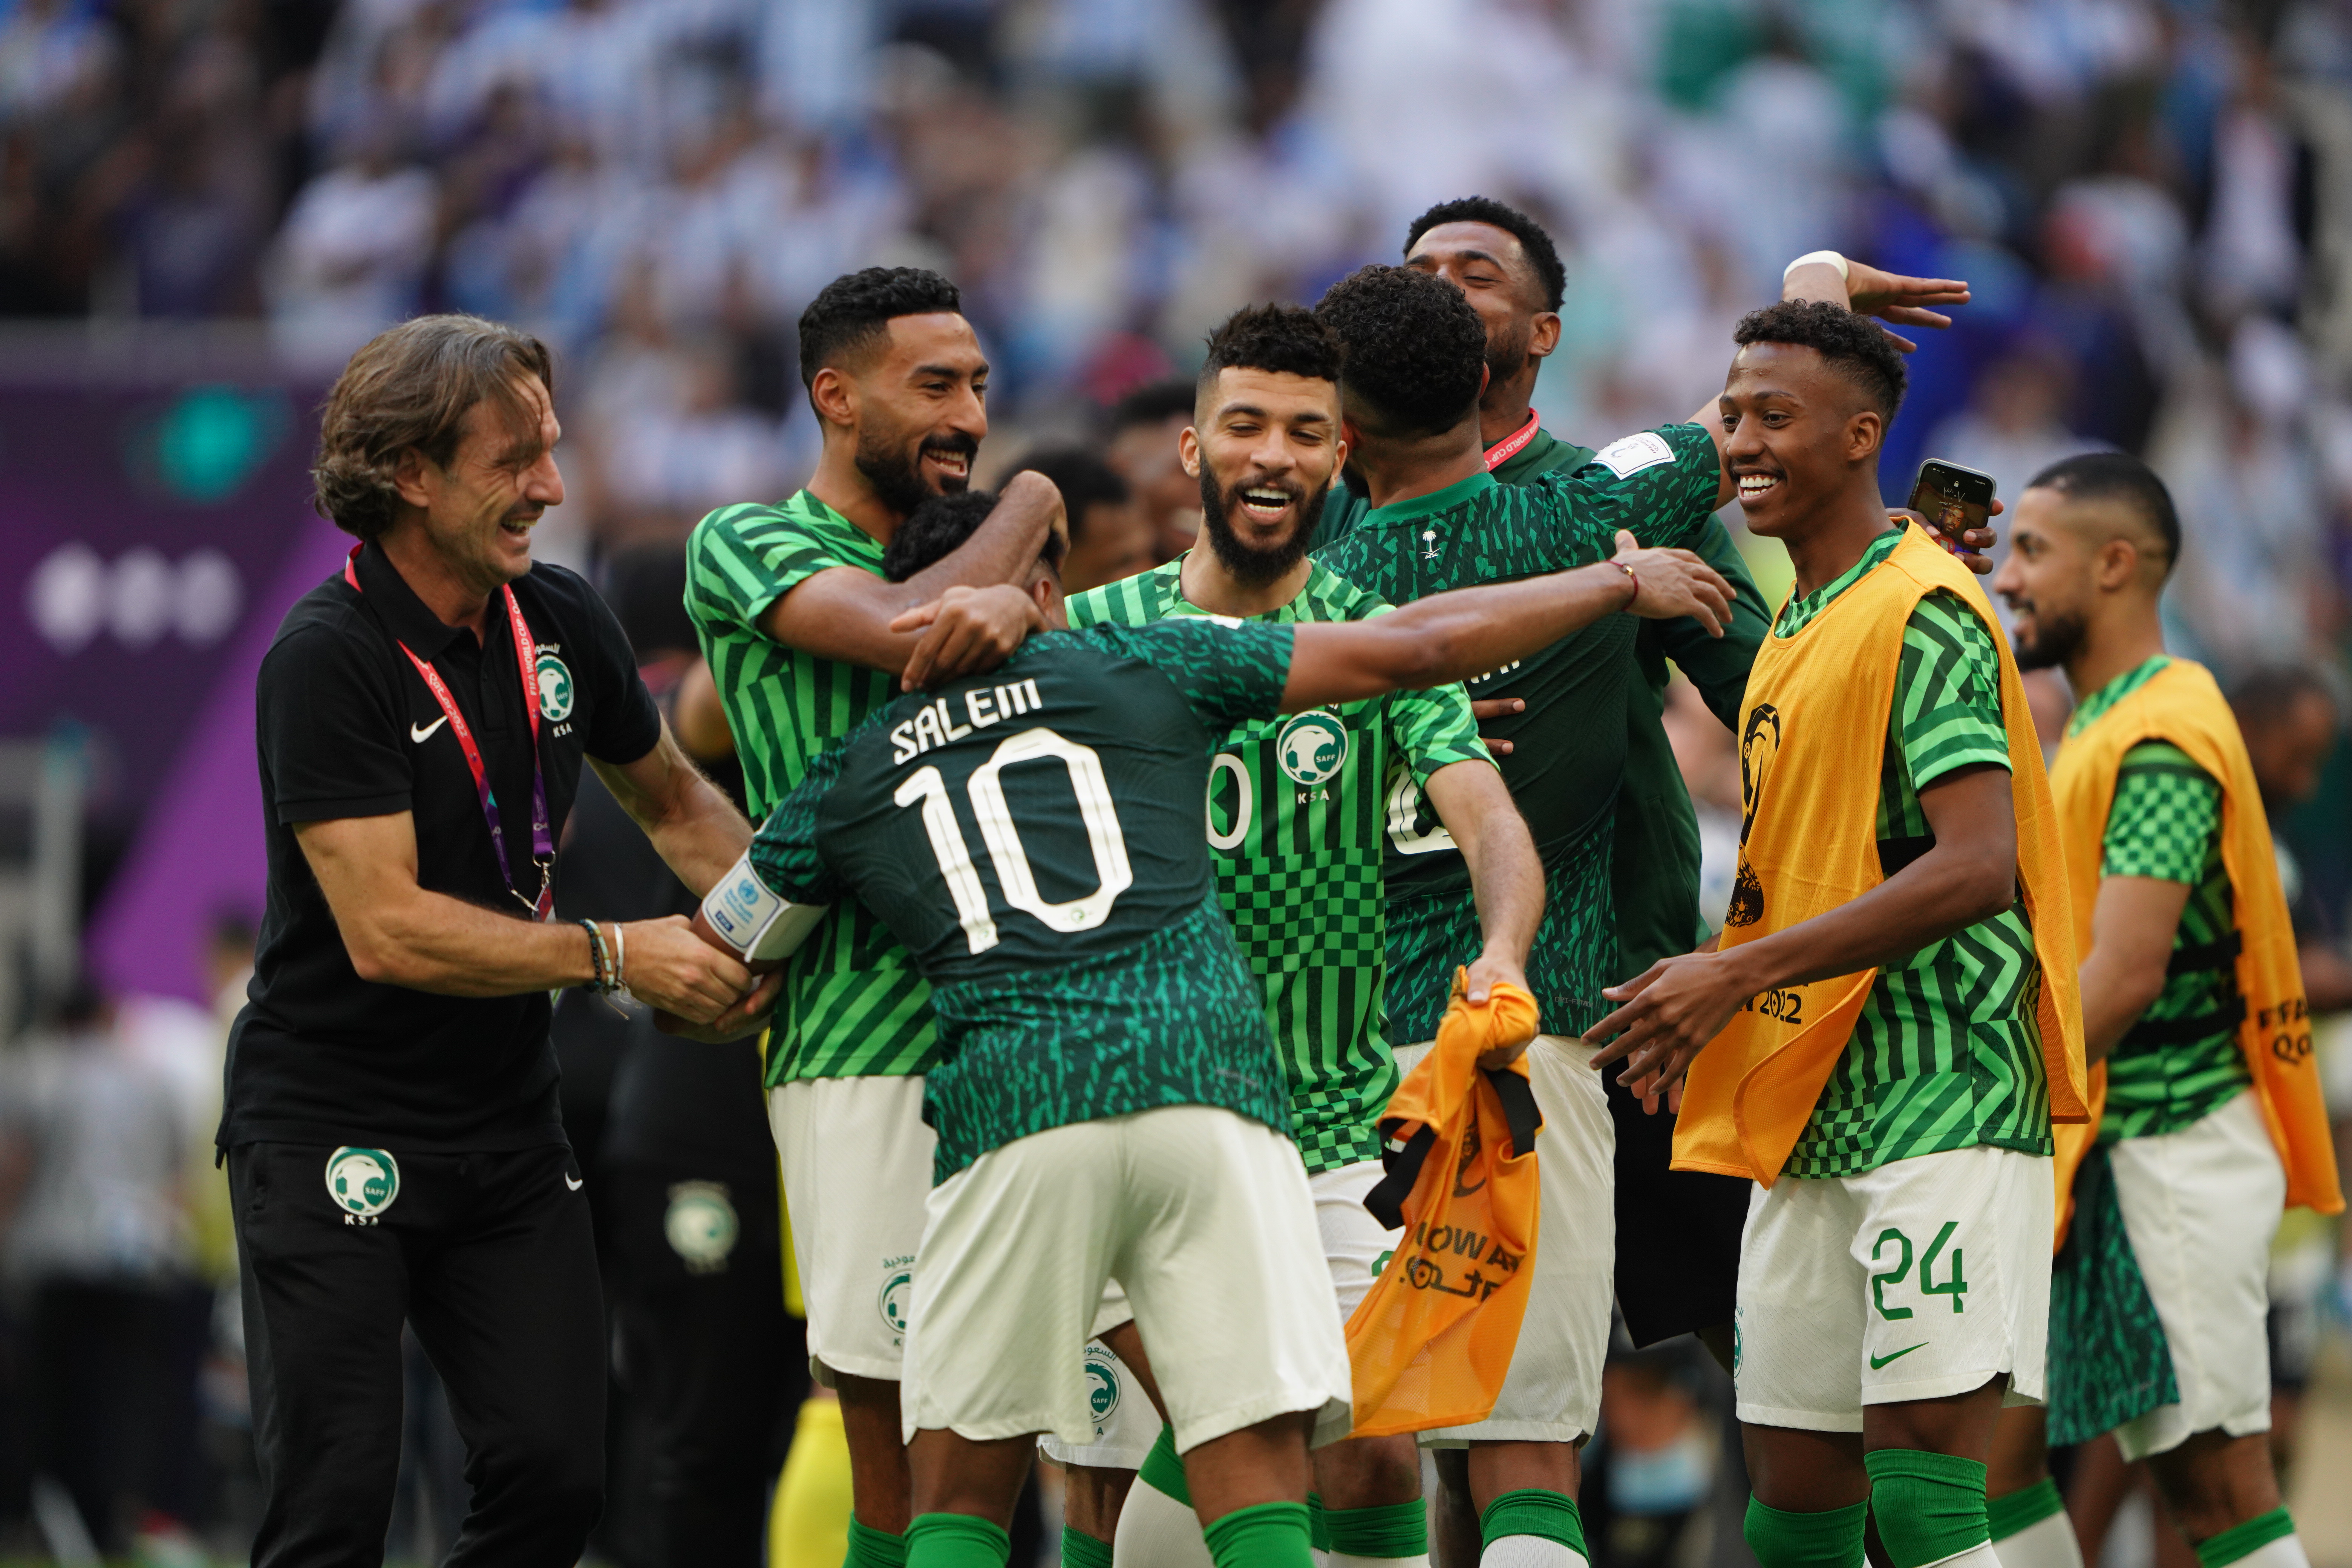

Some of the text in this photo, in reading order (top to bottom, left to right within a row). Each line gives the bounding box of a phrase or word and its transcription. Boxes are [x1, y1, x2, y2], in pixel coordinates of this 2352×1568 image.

[1506, 431, 1530, 452] WORLD
[1492, 448, 1506, 462] CUP
[516, 619, 537, 696] FIFA WORLD CUP
[889, 677, 1043, 766] SALEM
[553, 722, 573, 738] KSA
[1315, 754, 1336, 763] SAFF
[1297, 789, 1330, 804] KSA
[892, 726, 1133, 956] 10
[365, 1187, 385, 1197] SAFF
[344, 1213, 378, 1226] KSA
[1871, 1221, 1968, 1321] 24
